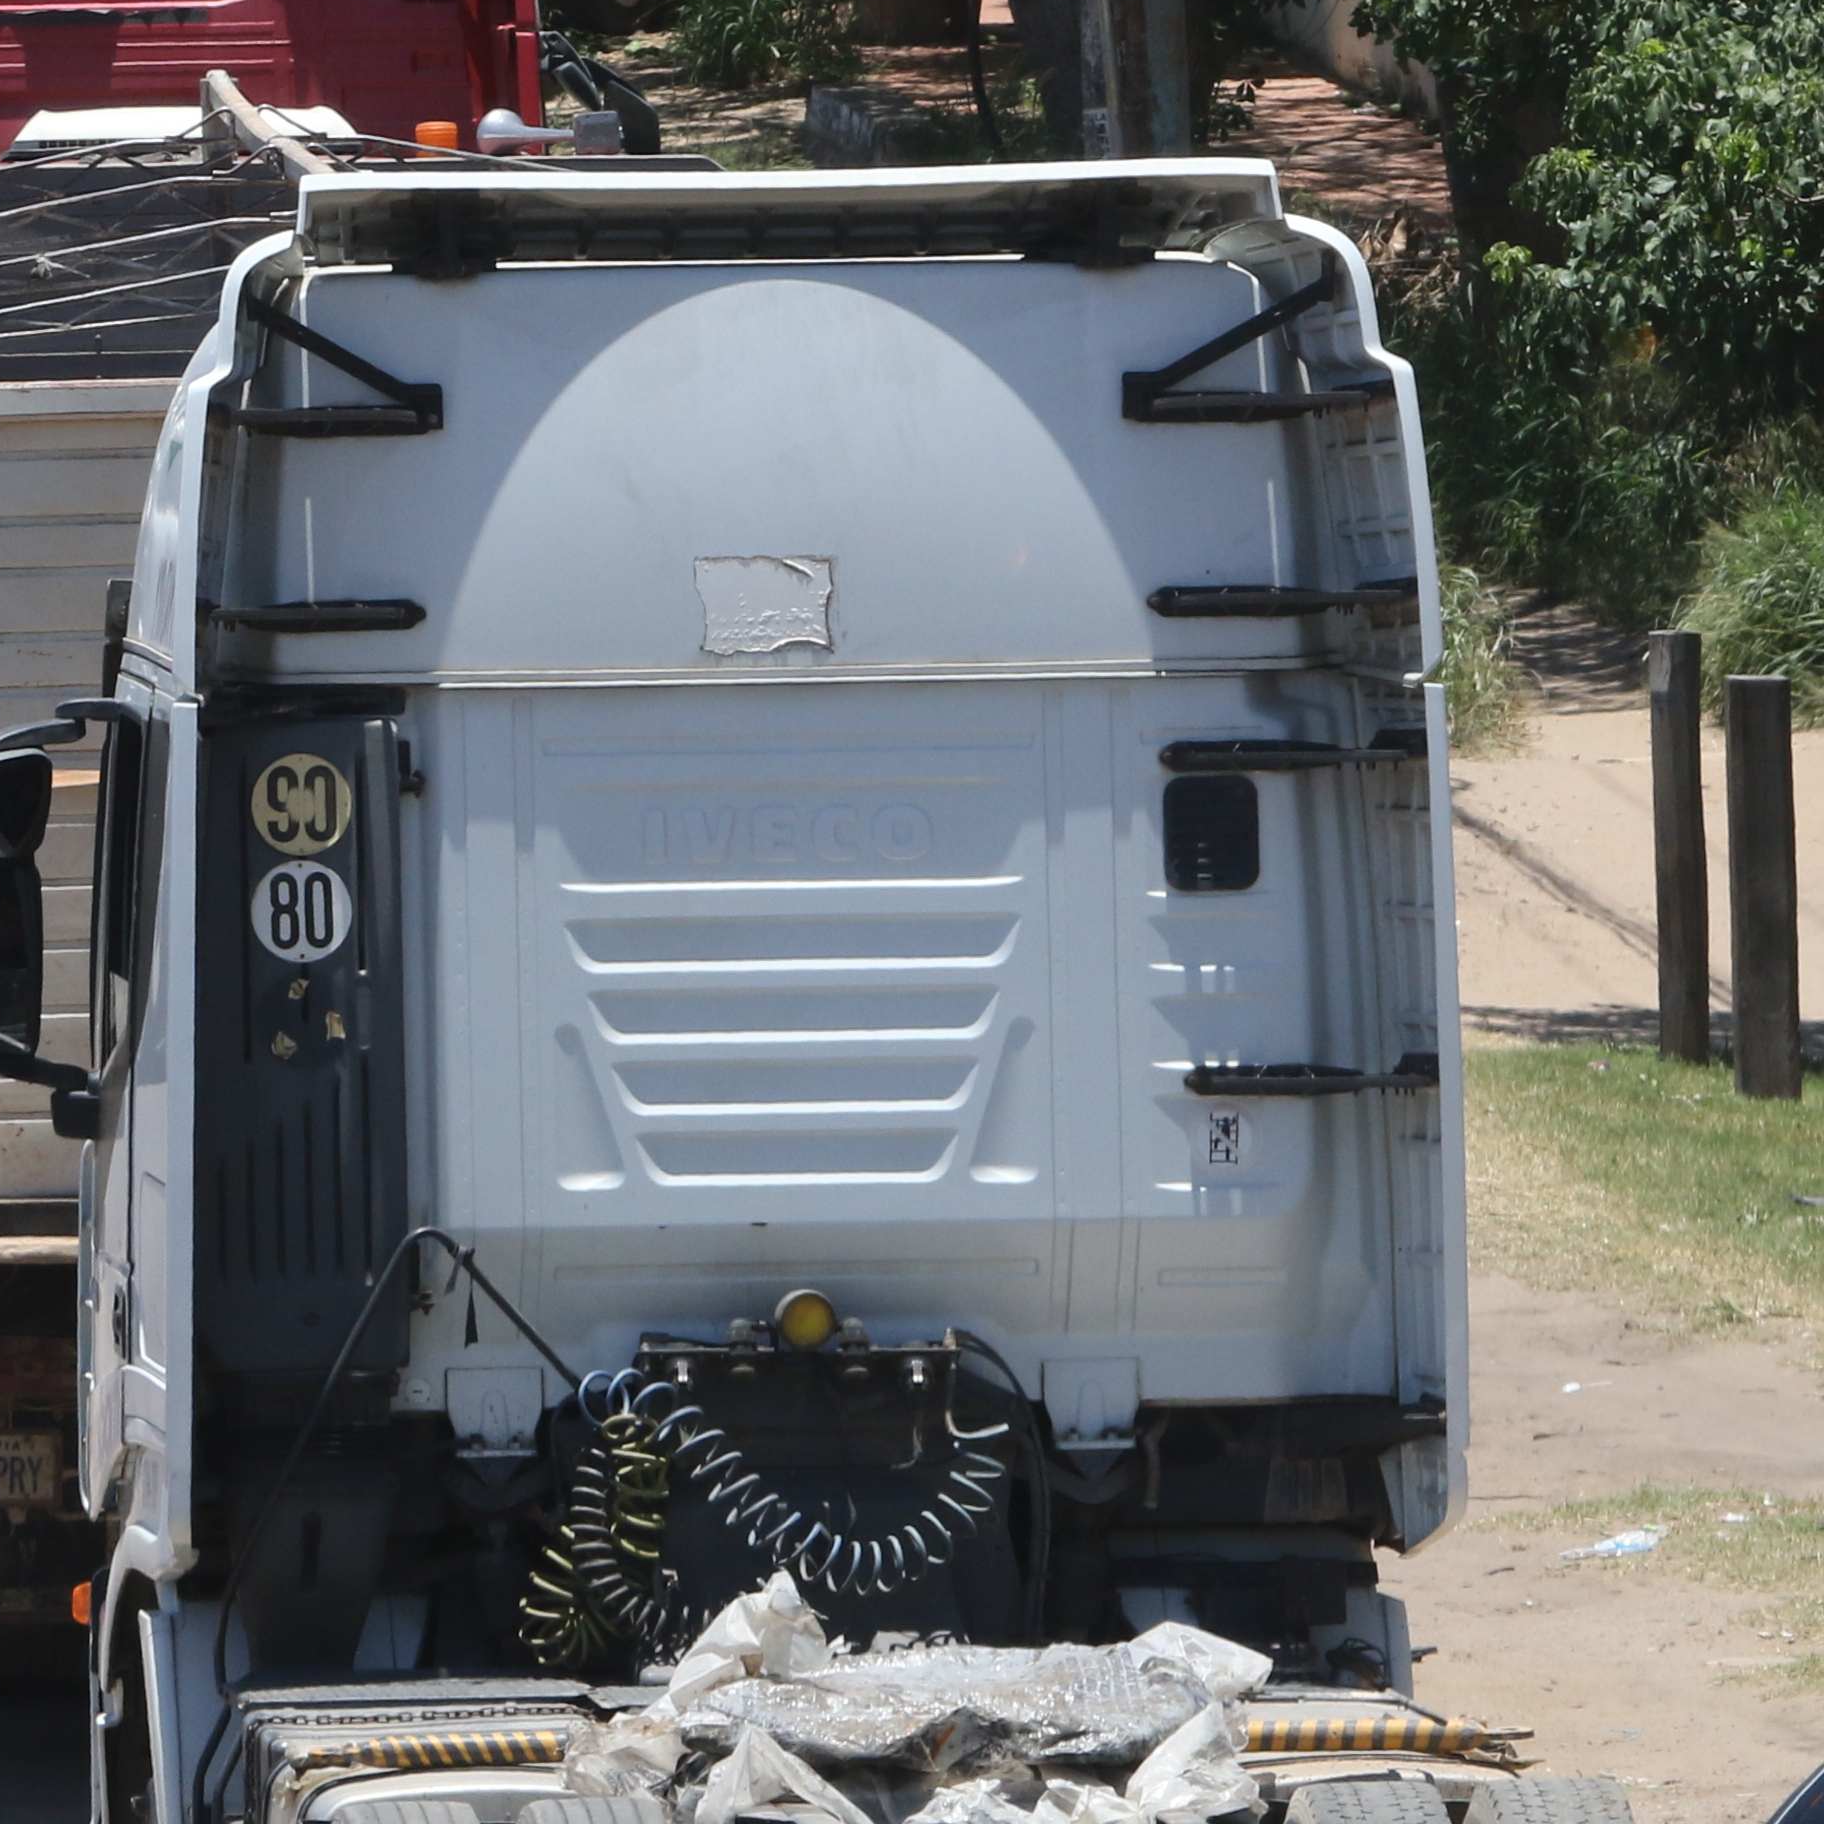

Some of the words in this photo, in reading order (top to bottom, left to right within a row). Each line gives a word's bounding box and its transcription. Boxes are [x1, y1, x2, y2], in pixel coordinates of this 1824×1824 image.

[266, 764, 337, 842] 90
[641, 803, 934, 865] IVECO
[270, 871, 335, 950] 80
